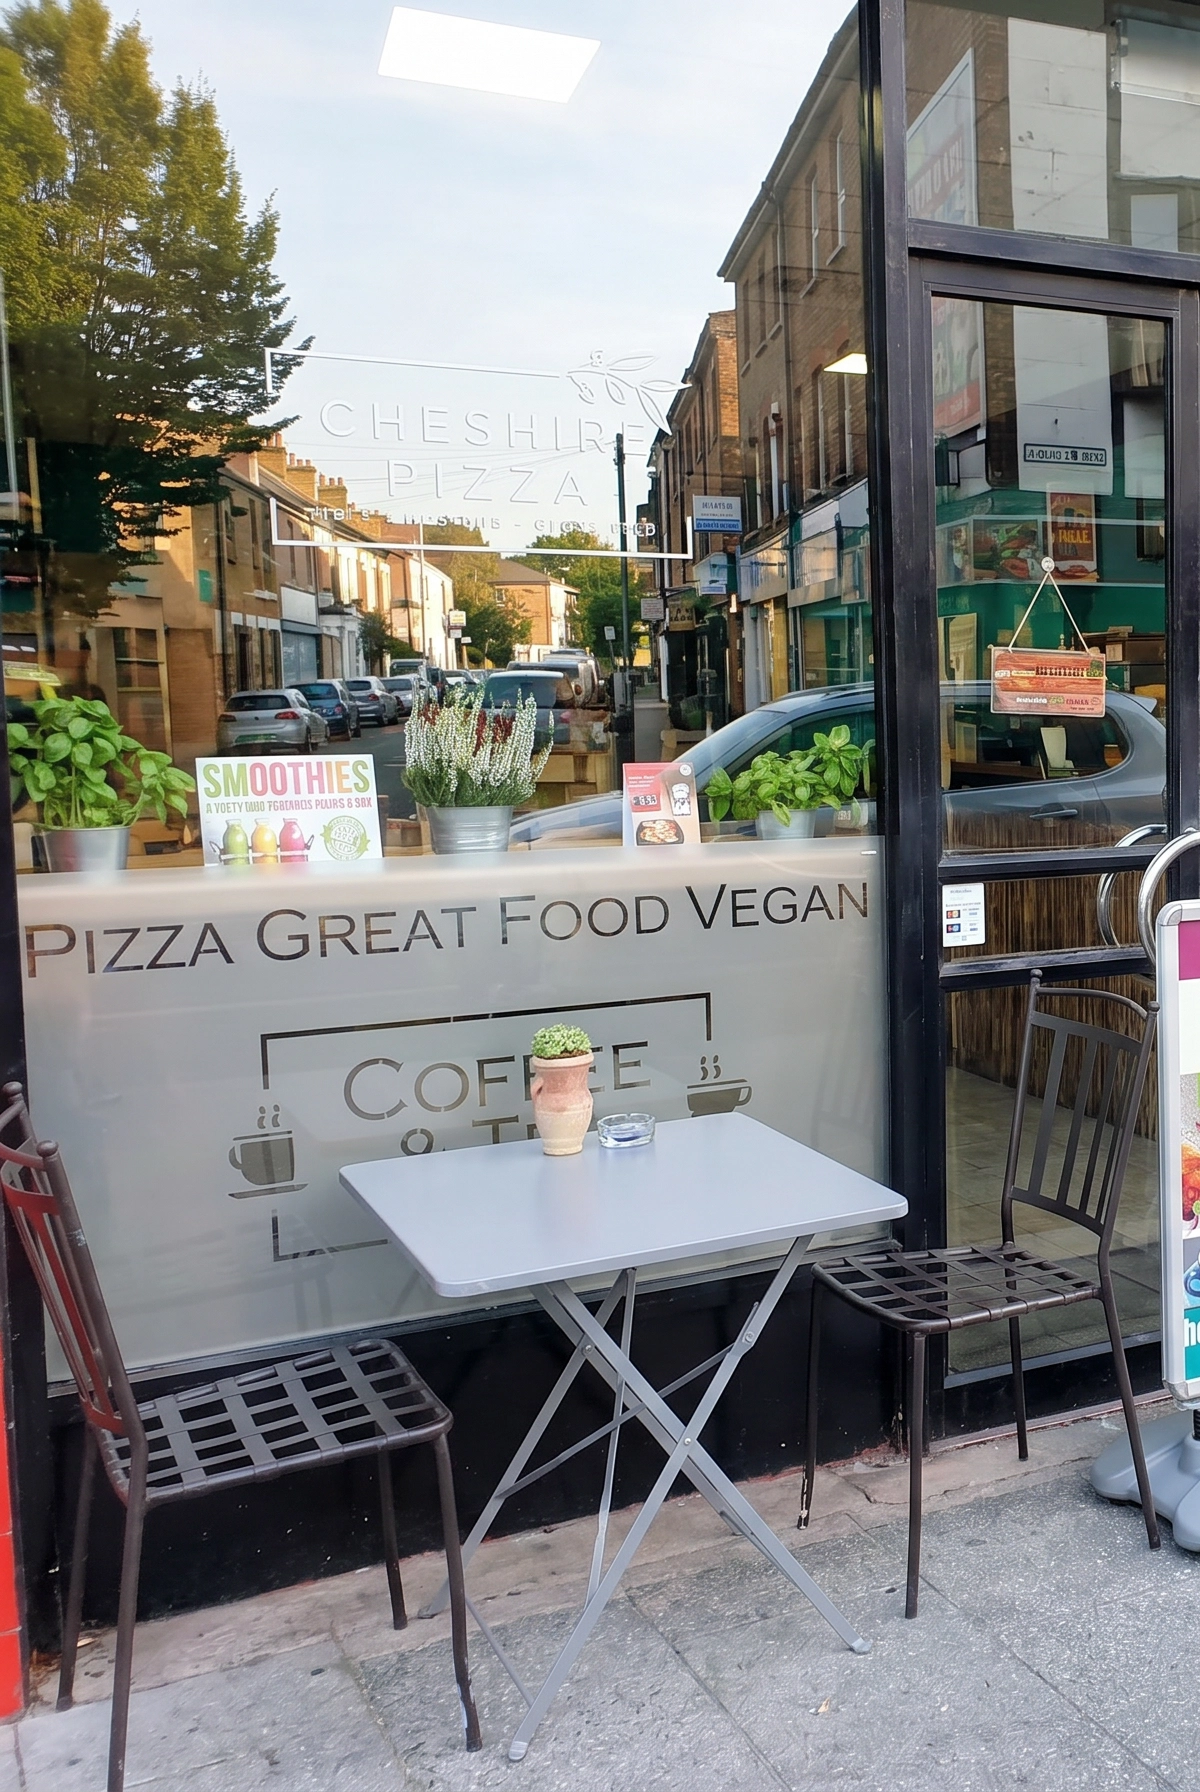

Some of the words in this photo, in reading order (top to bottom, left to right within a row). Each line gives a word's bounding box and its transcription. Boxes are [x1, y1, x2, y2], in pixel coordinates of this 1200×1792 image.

[320, 399, 647, 457] CHESHIRE
[387, 458, 588, 507] PIZZA
[202, 759, 370, 799] SMOOTHIES
[25, 921, 235, 979] PIZZA
[256, 905, 478, 962] GREAT
[500, 894, 670, 946] FOOD
[685, 882, 871, 931] VEGAN
